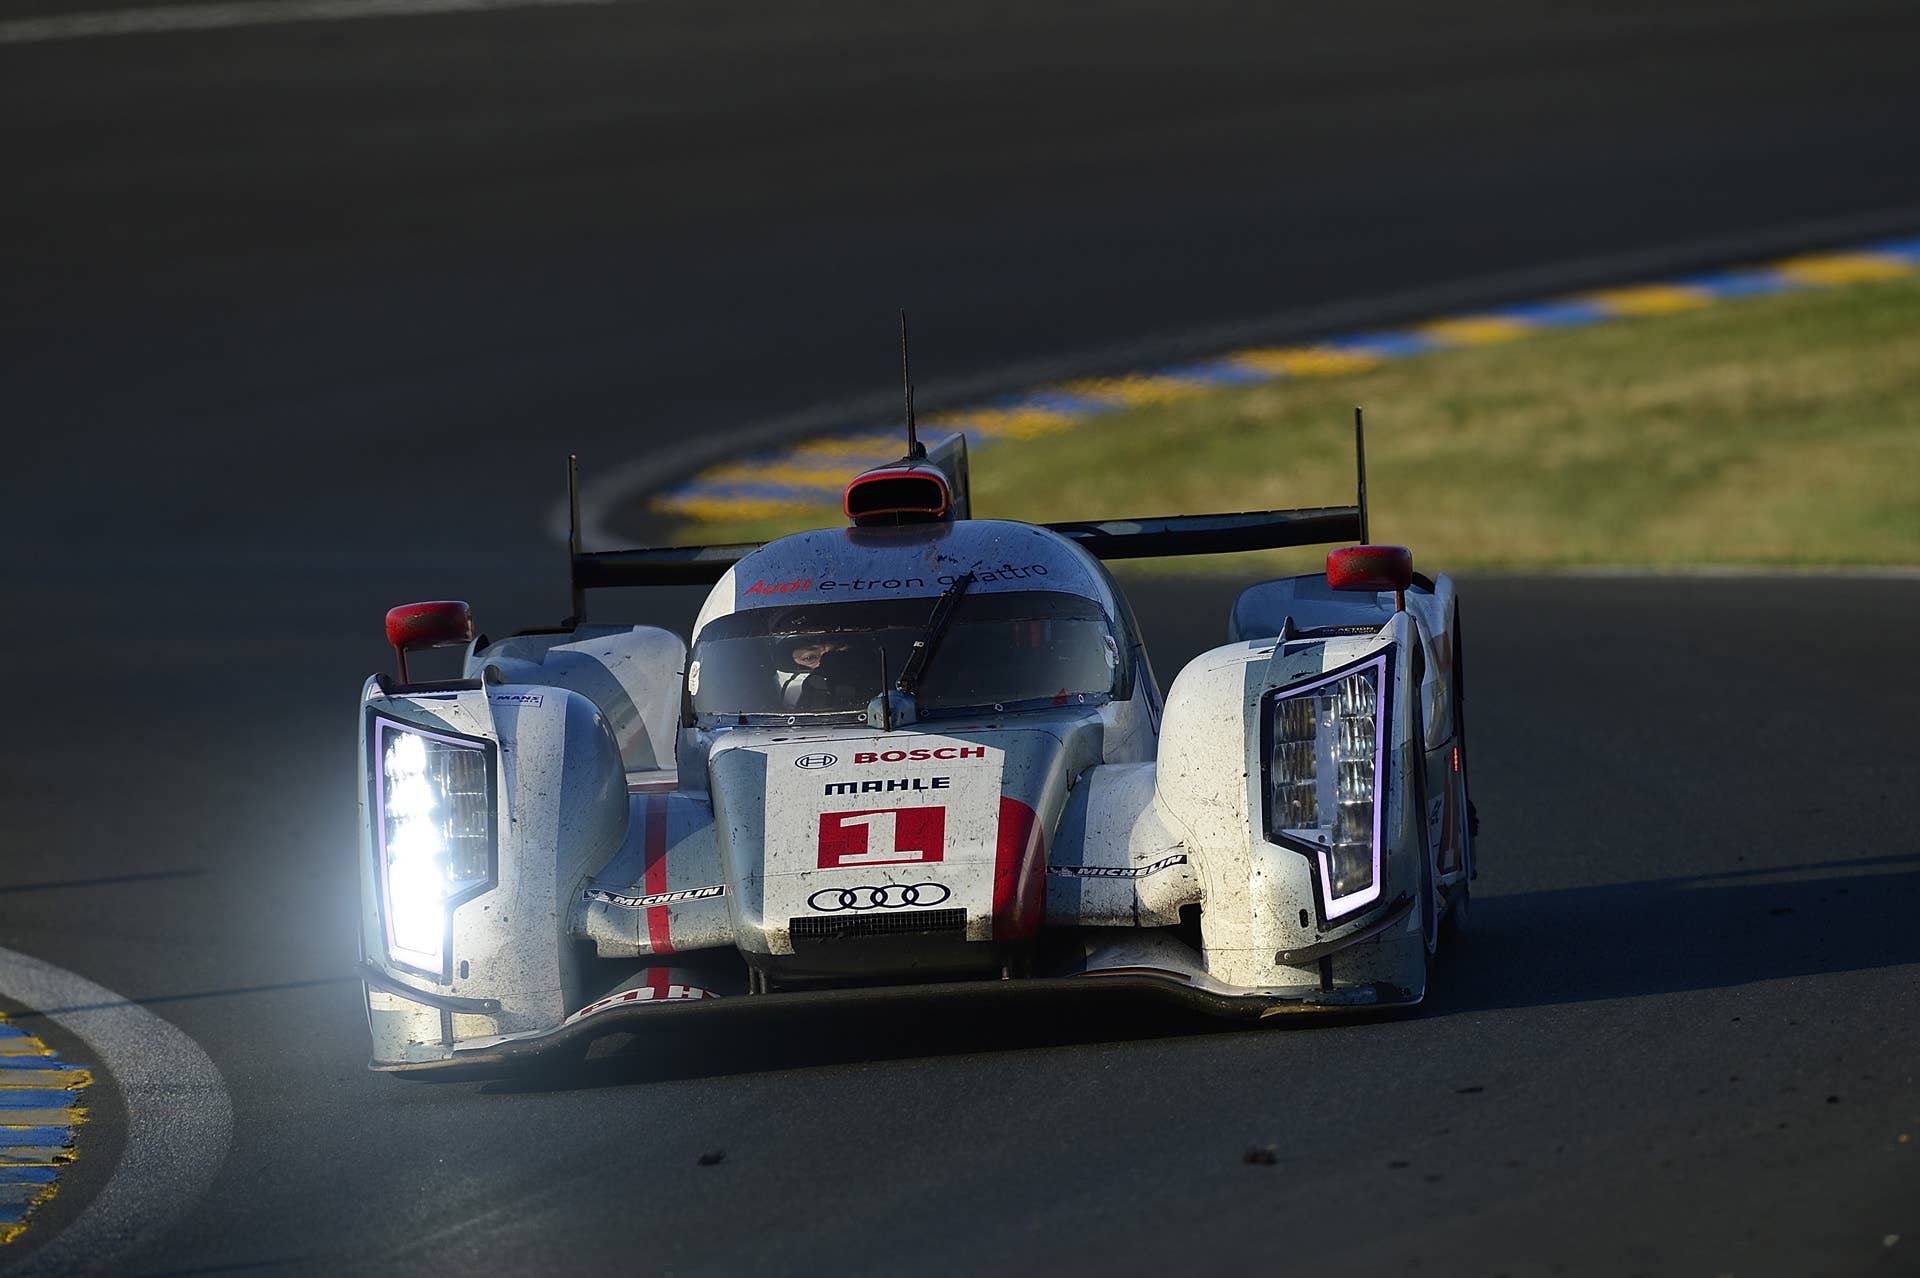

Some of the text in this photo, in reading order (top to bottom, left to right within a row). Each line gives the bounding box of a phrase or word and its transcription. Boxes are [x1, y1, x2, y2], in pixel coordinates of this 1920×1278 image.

[744, 577, 814, 596] Audi
[819, 577, 924, 592] e-tron
[854, 746, 985, 764] BOSCH
[824, 776, 950, 796] MAHLE
[838, 811, 923, 865] 1
[1077, 855, 1183, 877] MICHELIN
[613, 887, 720, 906] MICHELIN
